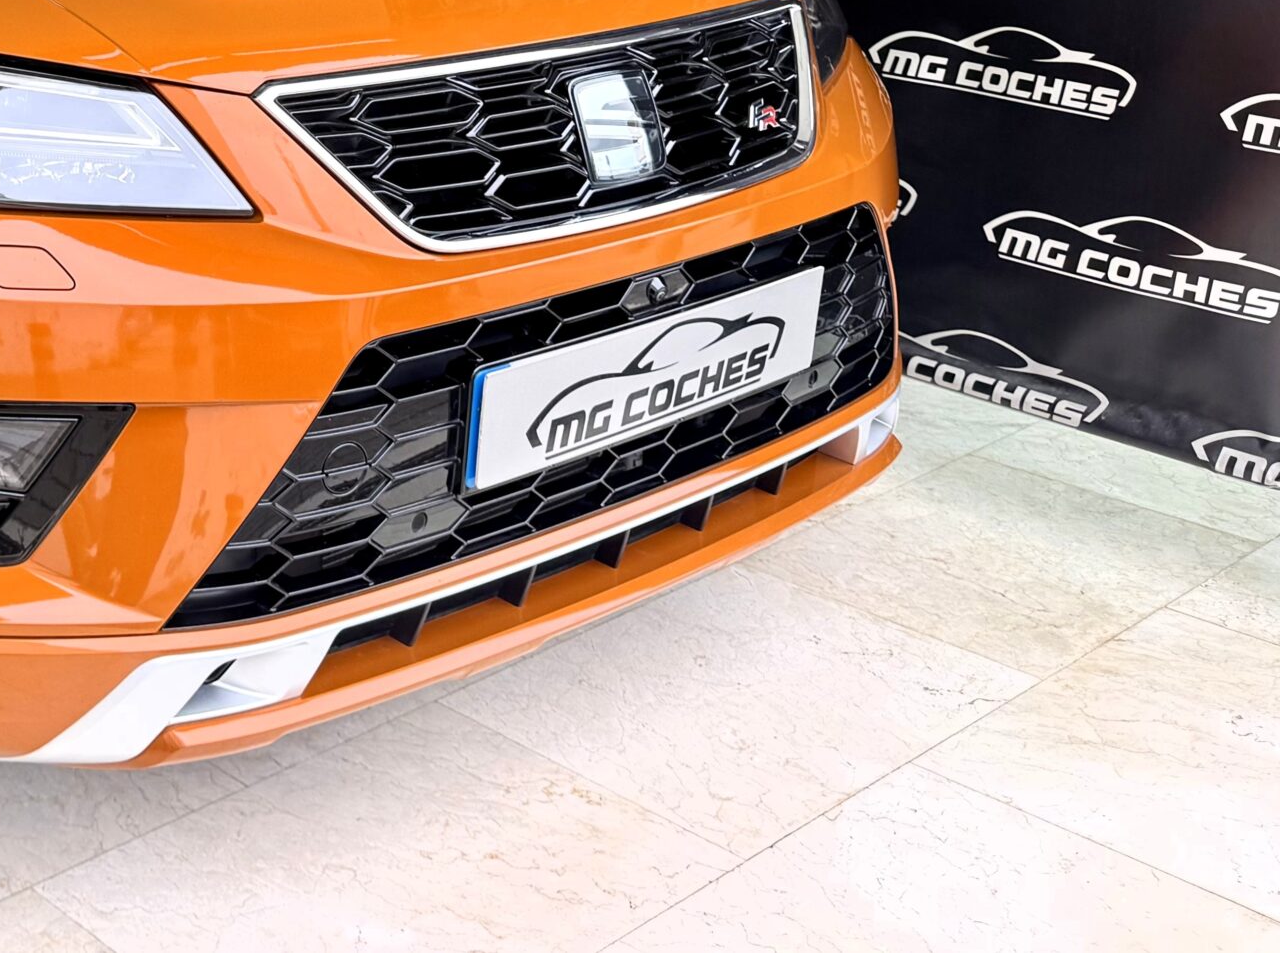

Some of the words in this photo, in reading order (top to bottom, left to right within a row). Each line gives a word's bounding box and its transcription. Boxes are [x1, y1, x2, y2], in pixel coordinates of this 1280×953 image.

[883, 49, 948, 81] MG
[956, 61, 1120, 114] COCHES
[999, 228, 1069, 268] MG
[1076, 249, 1280, 318] COCHES
[546, 404, 611, 453] MG
[622, 342, 769, 422] COCHES
[907, 356, 1087, 427] COCHES
